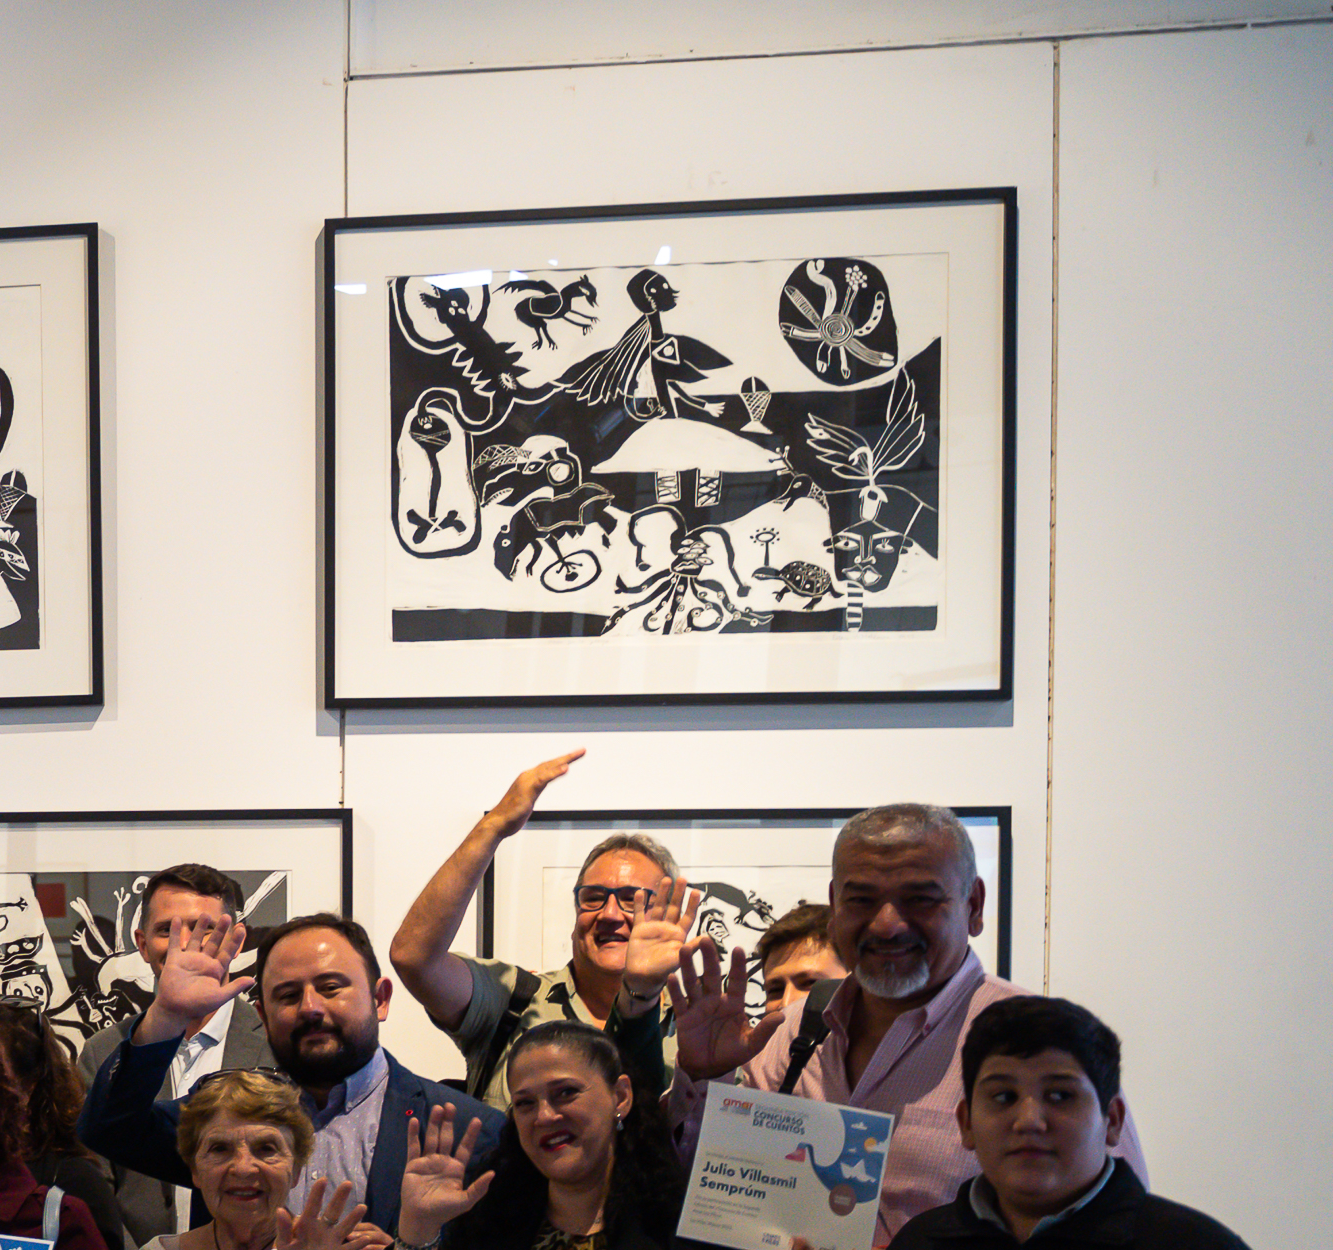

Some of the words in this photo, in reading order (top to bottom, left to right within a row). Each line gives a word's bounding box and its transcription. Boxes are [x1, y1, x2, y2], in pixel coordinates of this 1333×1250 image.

[723, 1098, 754, 1110] amar
[752, 1118, 764, 1127] DE
[765, 1121, 805, 1135] CUENTOS
[753, 1110, 803, 1126] CONCURSO
[702, 1161, 735, 1177] Julio
[740, 1167, 797, 1189] Villasmil
[699, 1176, 766, 1199] Semprúm
